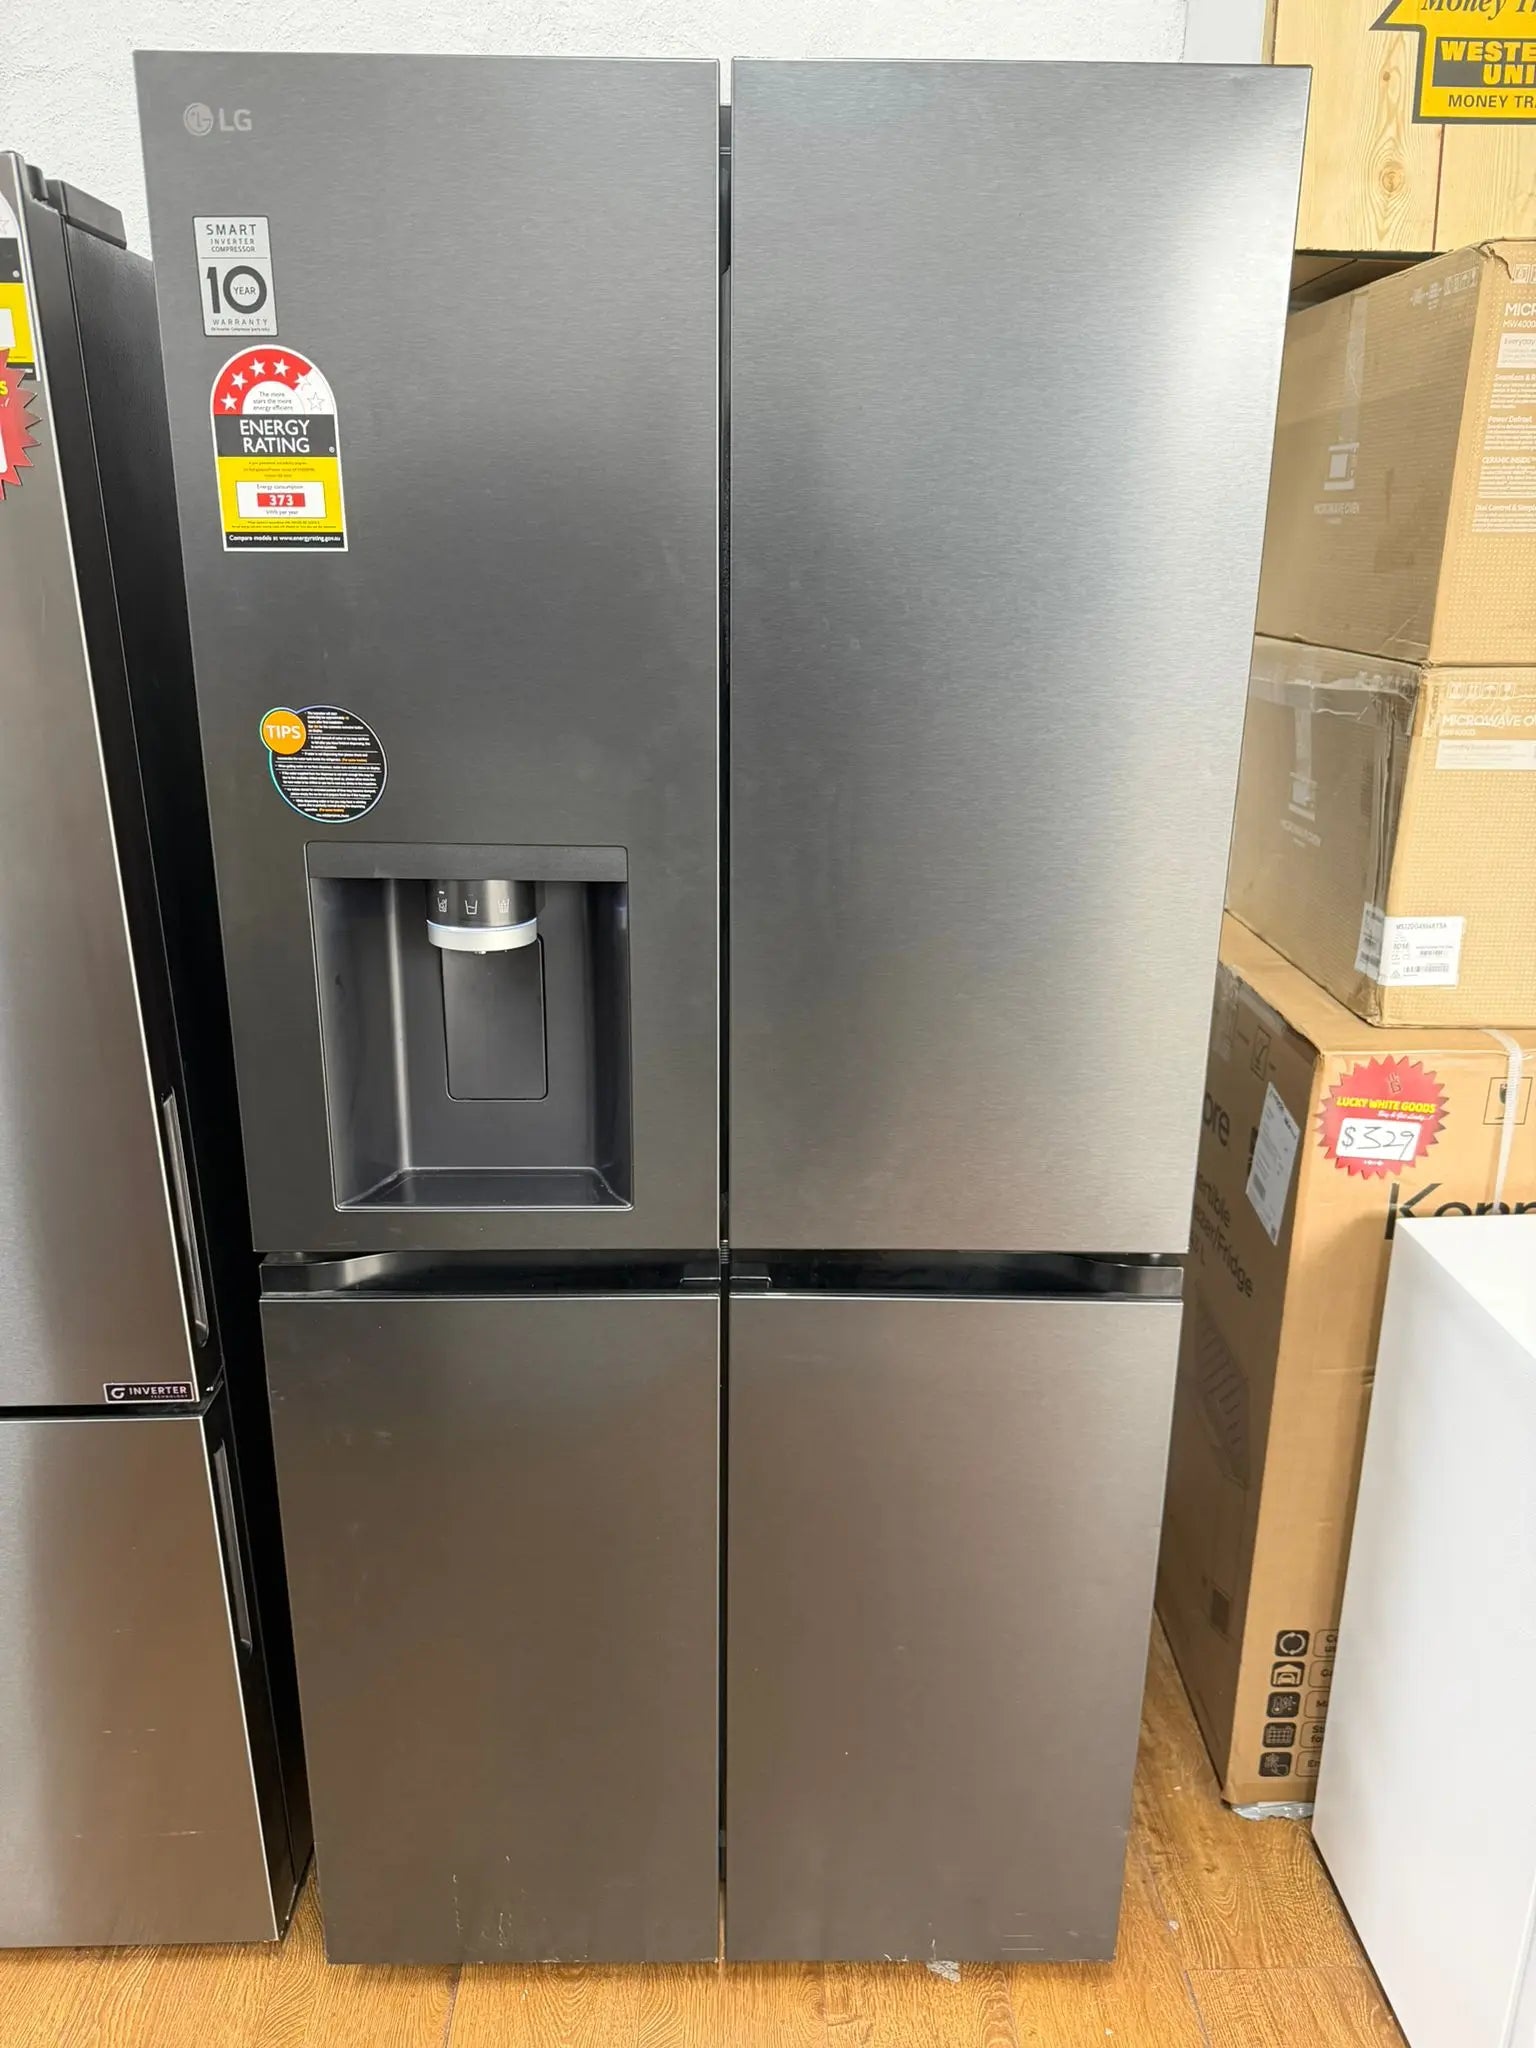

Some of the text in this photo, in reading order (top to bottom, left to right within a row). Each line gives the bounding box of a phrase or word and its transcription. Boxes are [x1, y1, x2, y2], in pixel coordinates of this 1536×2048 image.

[1448, 95, 1508, 108] MONEY
[219, 108, 252, 131] LG
[206, 224, 257, 236] SMART
[206, 265, 268, 314] 10
[233, 286, 257, 295] YEAR
[240, 419, 310, 435] ENERGY
[243, 437, 310, 453] RATING
[269, 494, 294, 506] 373
[228, 535, 252, 543] Compare
[1442, 714, 1536, 728] MICROWAVE O
[266, 725, 302, 740] TIPS
[1336, 1096, 1436, 1114] LUCKY WHITE GOODS
[128, 1386, 188, 1396] INVERTER
